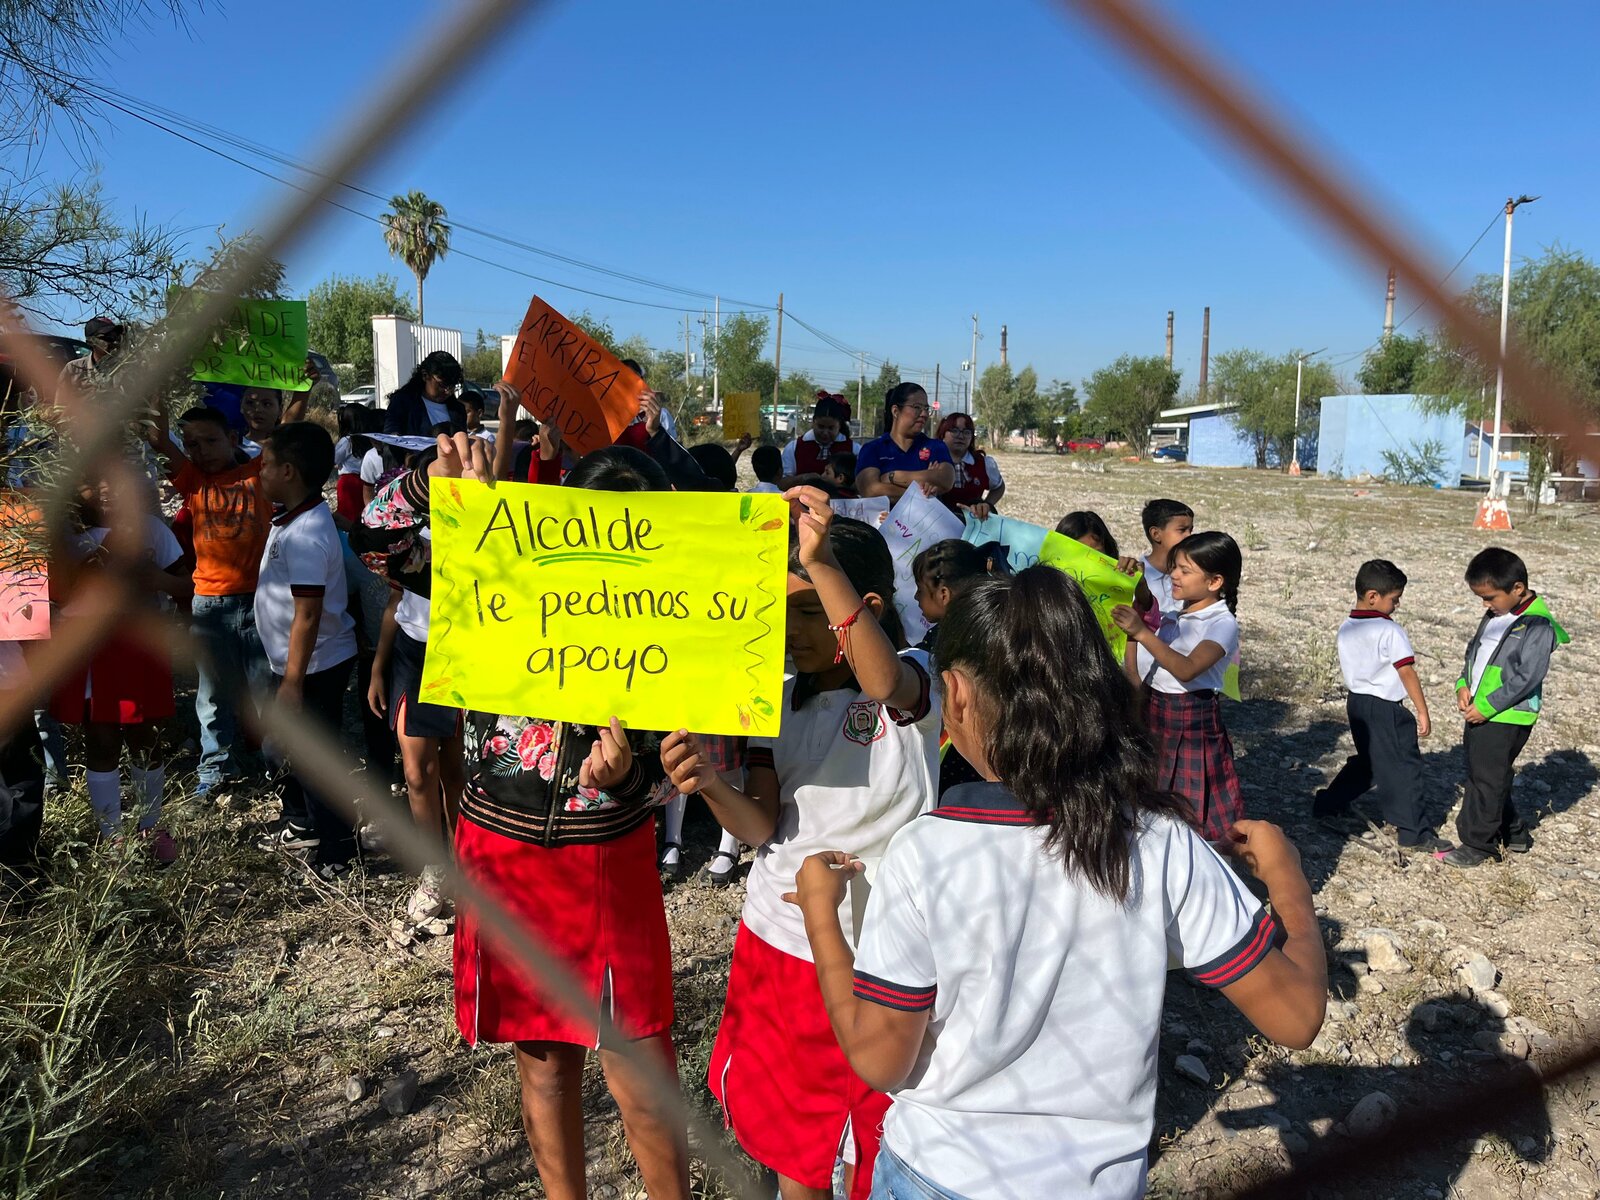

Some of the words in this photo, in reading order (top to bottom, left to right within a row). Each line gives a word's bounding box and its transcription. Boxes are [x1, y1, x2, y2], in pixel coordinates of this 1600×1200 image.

[190, 355, 226, 376] OR
[240, 360, 313, 387] VENIR
[517, 340, 537, 374] EL
[527, 312, 621, 401] ARRIBA
[474, 497, 666, 557] Alcalde
[473, 579, 514, 628] le
[539, 579, 691, 639] pedimos
[706, 589, 749, 622] su
[526, 643, 669, 693] apoyo
